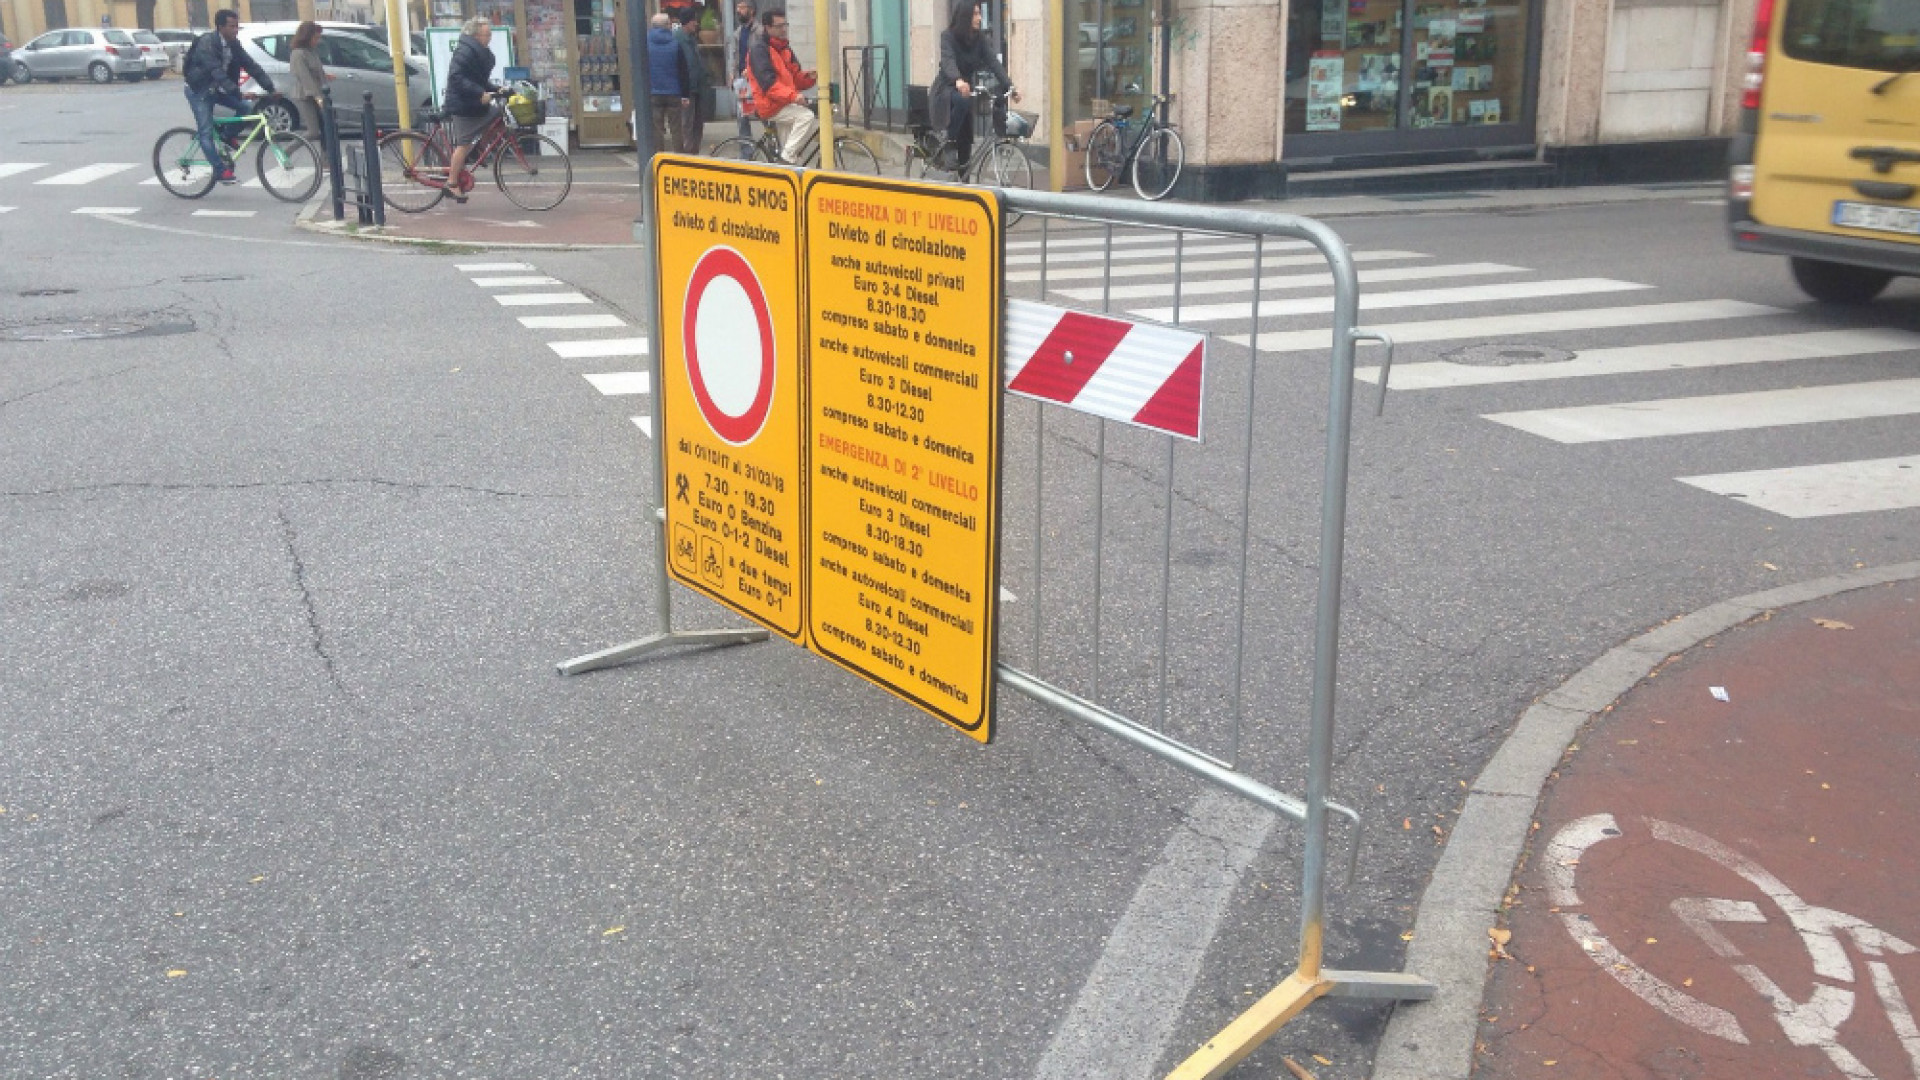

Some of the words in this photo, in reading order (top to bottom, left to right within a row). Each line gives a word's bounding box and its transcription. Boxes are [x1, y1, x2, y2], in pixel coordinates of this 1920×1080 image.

[664, 176, 741, 204] EMERGENZA
[748, 187, 788, 211] SMOG
[673, 211, 705, 231] divieto
[708, 217, 717, 232] di
[722, 218, 780, 244] circolazione
[817, 197, 889, 223] EMERGENZA
[895, 208, 907, 225] DI
[928, 212, 978, 236] LIVELLO
[828, 221, 870, 243] Divieto
[875, 229, 886, 247] di
[892, 232, 966, 261] circolazione
[831, 254, 861, 271] anche
[866, 261, 922, 282] autoveicoli
[927, 272, 964, 292] privati
[854, 275, 877, 293] Euro
[883, 281, 900, 298] 3-4
[906, 286, 939, 307] Diesel
[867, 297, 926, 323] 8.30-18.30
[822, 309, 868, 329] compreso
[874, 319, 908, 340] sabato
[914, 331, 920, 342] e
[925, 331, 976, 357] domenica
[819, 337, 848, 354] anche
[853, 345, 908, 370] autoveicoli
[913, 361, 978, 389] commerciali
[860, 368, 883, 386] Euro
[888, 376, 895, 389] 3
[900, 379, 932, 401] Diesel
[867, 393, 924, 423] 8.30-12.30
[823, 406, 868, 428] compreso
[873, 421, 908, 442] sabato
[913, 435, 918, 446] e
[923, 435, 974, 465] domenica
[679, 438, 691, 454] dal
[695, 444, 729, 469] 01/10/17
[733, 460, 741, 475] al
[745, 464, 784, 493] 31/03/18
[819, 433, 889, 470] EMERGENZA
[894, 458, 907, 476] DI
[929, 469, 978, 501] LIVELLO
[705, 472, 728, 496] 7.30
[744, 488, 774, 516] 19.30
[821, 464, 848, 484] anche
[853, 476, 907, 505] autoveicoli
[912, 498, 976, 532] commerciali
[699, 490, 722, 514] Euro
[741, 509, 782, 542] Benzina
[859, 498, 882, 518] Euro
[887, 508, 894, 522] 3
[900, 512, 930, 538] Diesel
[693, 508, 716, 532] Euro
[722, 522, 750, 548] 0-1-2
[756, 536, 789, 568] Diesel
[866, 523, 922, 558] 8.30-18.30
[739, 559, 757, 579] due
[762, 570, 791, 597] tempi
[823, 530, 868, 557] compreso
[873, 551, 906, 574] sabato
[912, 567, 917, 579] e
[921, 570, 971, 603] domenica
[739, 577, 761, 600] Euro
[766, 591, 782, 612] 0-1
[820, 556, 848, 577] anche
[852, 569, 906, 603] autoveicoli
[910, 597, 973, 635] commerciali
[858, 592, 881, 614] Euro
[885, 605, 892, 619] 4
[898, 610, 928, 637] Diesel
[865, 617, 920, 655] 8.30-12.30
[822, 621, 866, 651] compreso
[871, 645, 904, 670] sabato
[909, 665, 915, 676] e
[920, 668, 968, 705] domenica
